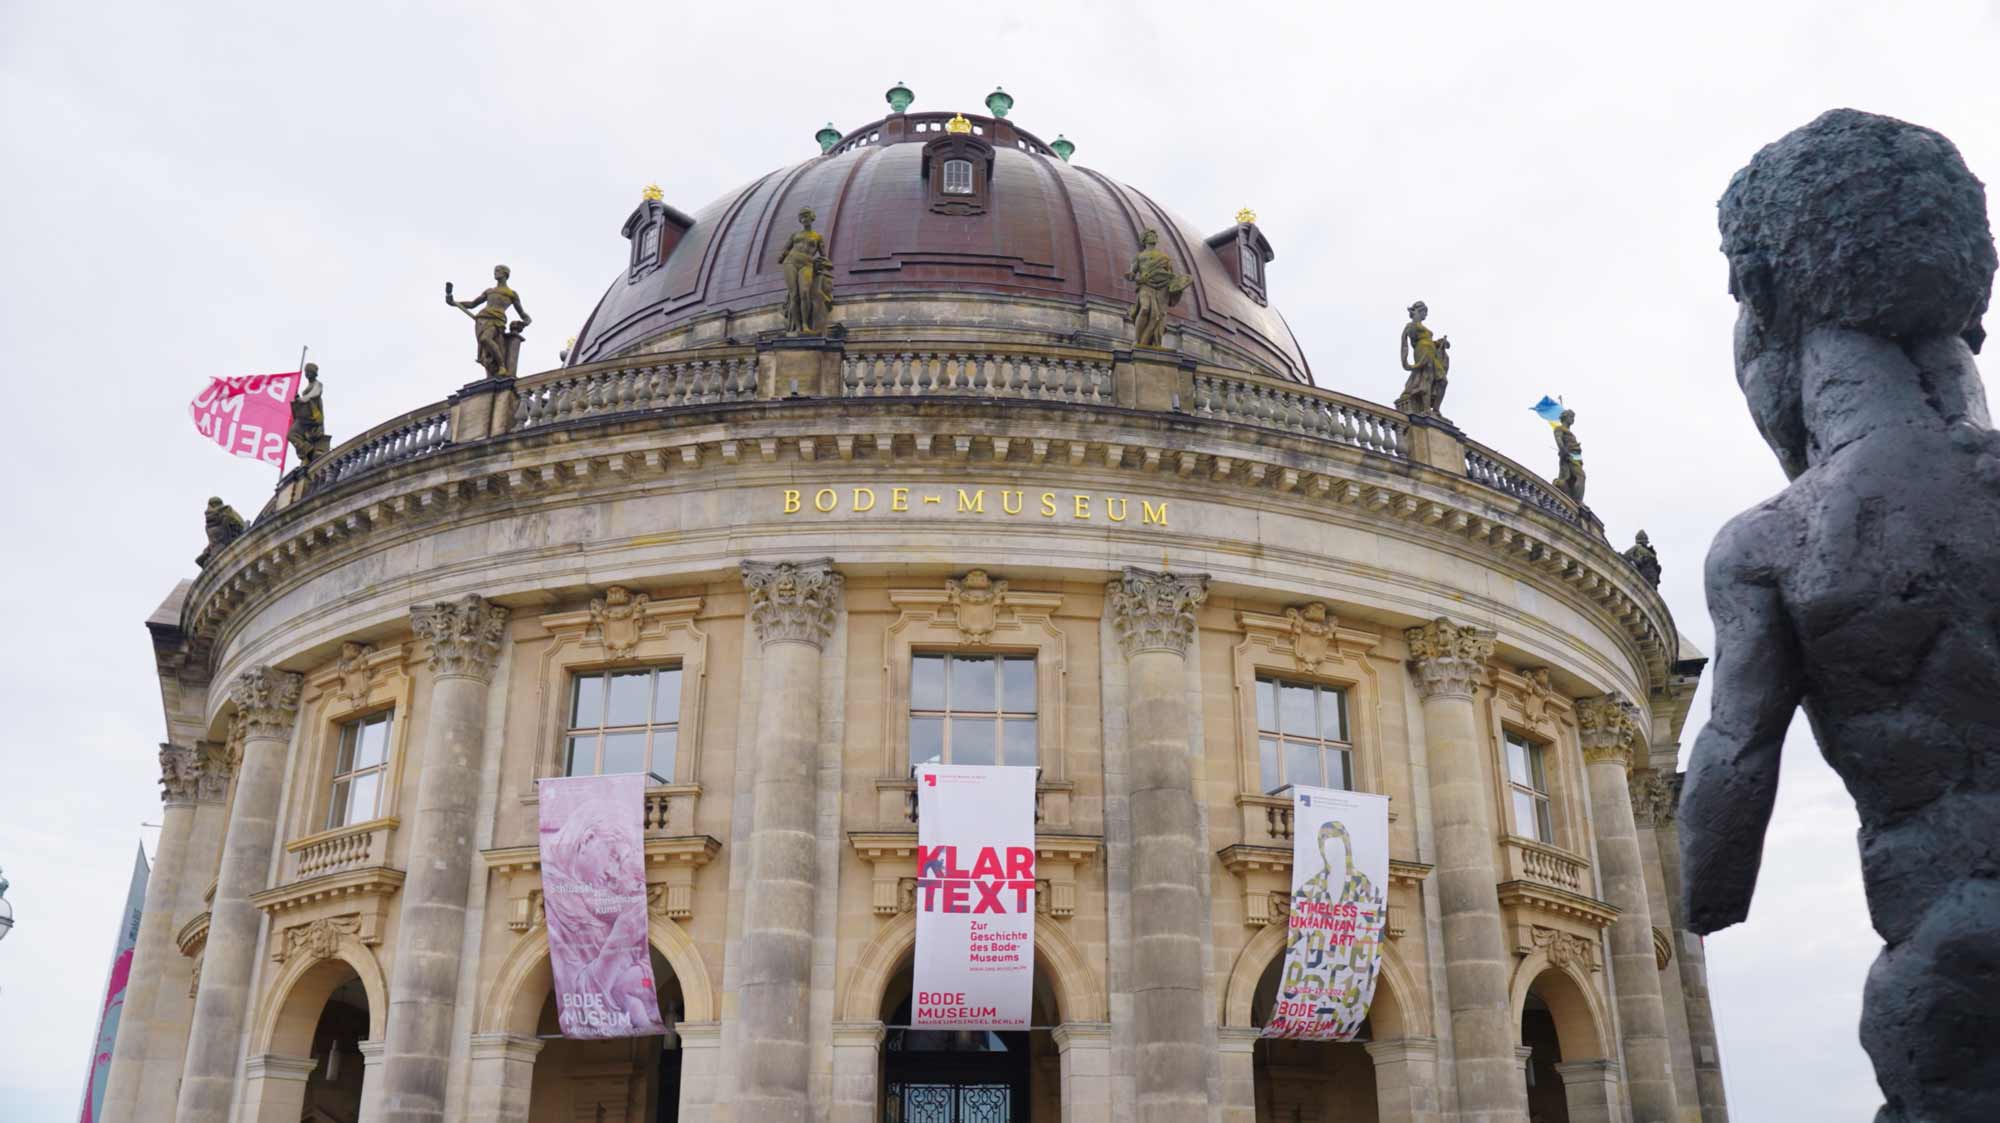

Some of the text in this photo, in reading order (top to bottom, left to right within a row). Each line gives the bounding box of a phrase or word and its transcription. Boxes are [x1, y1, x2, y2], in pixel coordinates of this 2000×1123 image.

[783, 488, 1169, 525] BODE-MUSEUM
[918, 846, 1034, 879] KLAR
[918, 880, 1035, 913] TEXT
[1299, 901, 1358, 918] TIMELESS
[971, 921, 988, 930] Zur
[970, 931, 1028, 941] Geschichte
[1329, 933, 1355, 946] ART
[970, 942, 1020, 951] des Bode-
[970, 953, 1019, 962] Museums
[562, 993, 604, 1008] BODE
[919, 991, 966, 1005] BODE
[918, 1007, 996, 1018] MUSEUM
[1278, 1001, 1317, 1017] BODE
[565, 1010, 632, 1026] MUSEUM
[1272, 1018, 1336, 1032] MUSEUM
